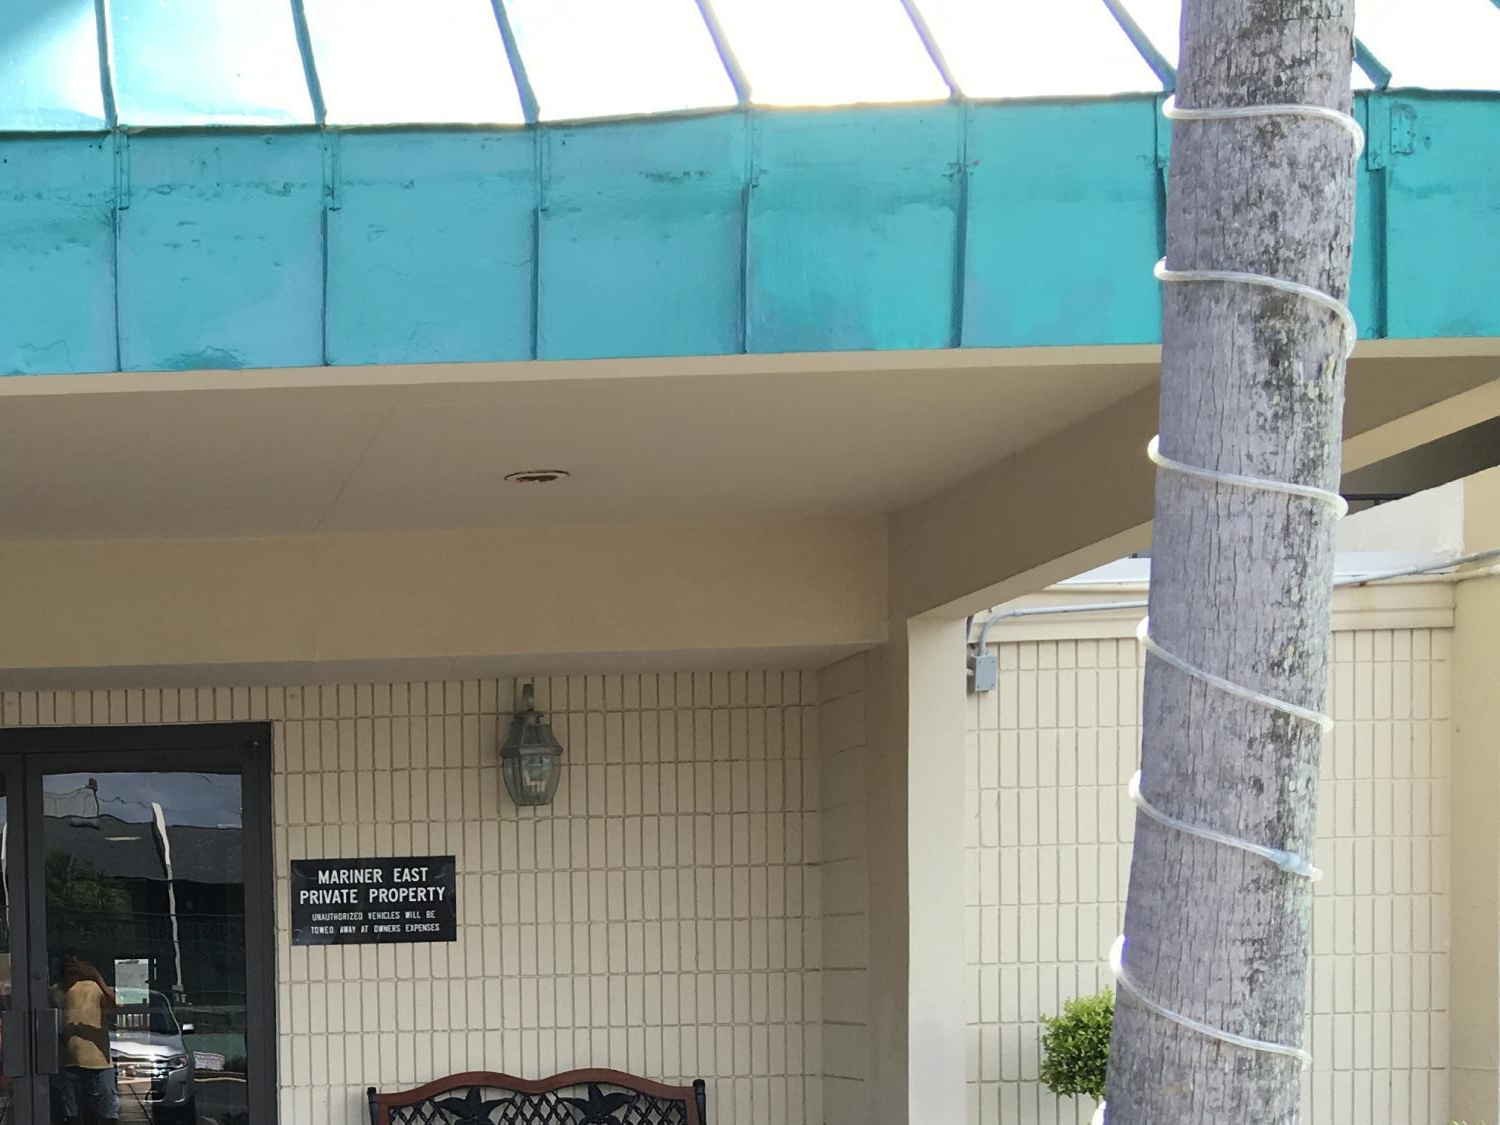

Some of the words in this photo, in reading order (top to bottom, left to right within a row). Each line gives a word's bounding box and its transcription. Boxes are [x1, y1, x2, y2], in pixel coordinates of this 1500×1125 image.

[318, 869, 382, 884] MARINER
[394, 867, 428, 882] EAST
[300, 889, 358, 904] PRIVATE
[369, 887, 445, 903] PROPERTY
[312, 912, 363, 921] UNAUTHORIZED
[368, 911, 400, 920] VEHICLES
[405, 911, 420, 919] WILL
[426, 910, 436, 918] BE
[311, 926, 334, 934] TOWED
[361, 925, 368, 933] AT
[374, 924, 401, 933] OWNERS
[405, 923, 440, 932] EXPENSES
